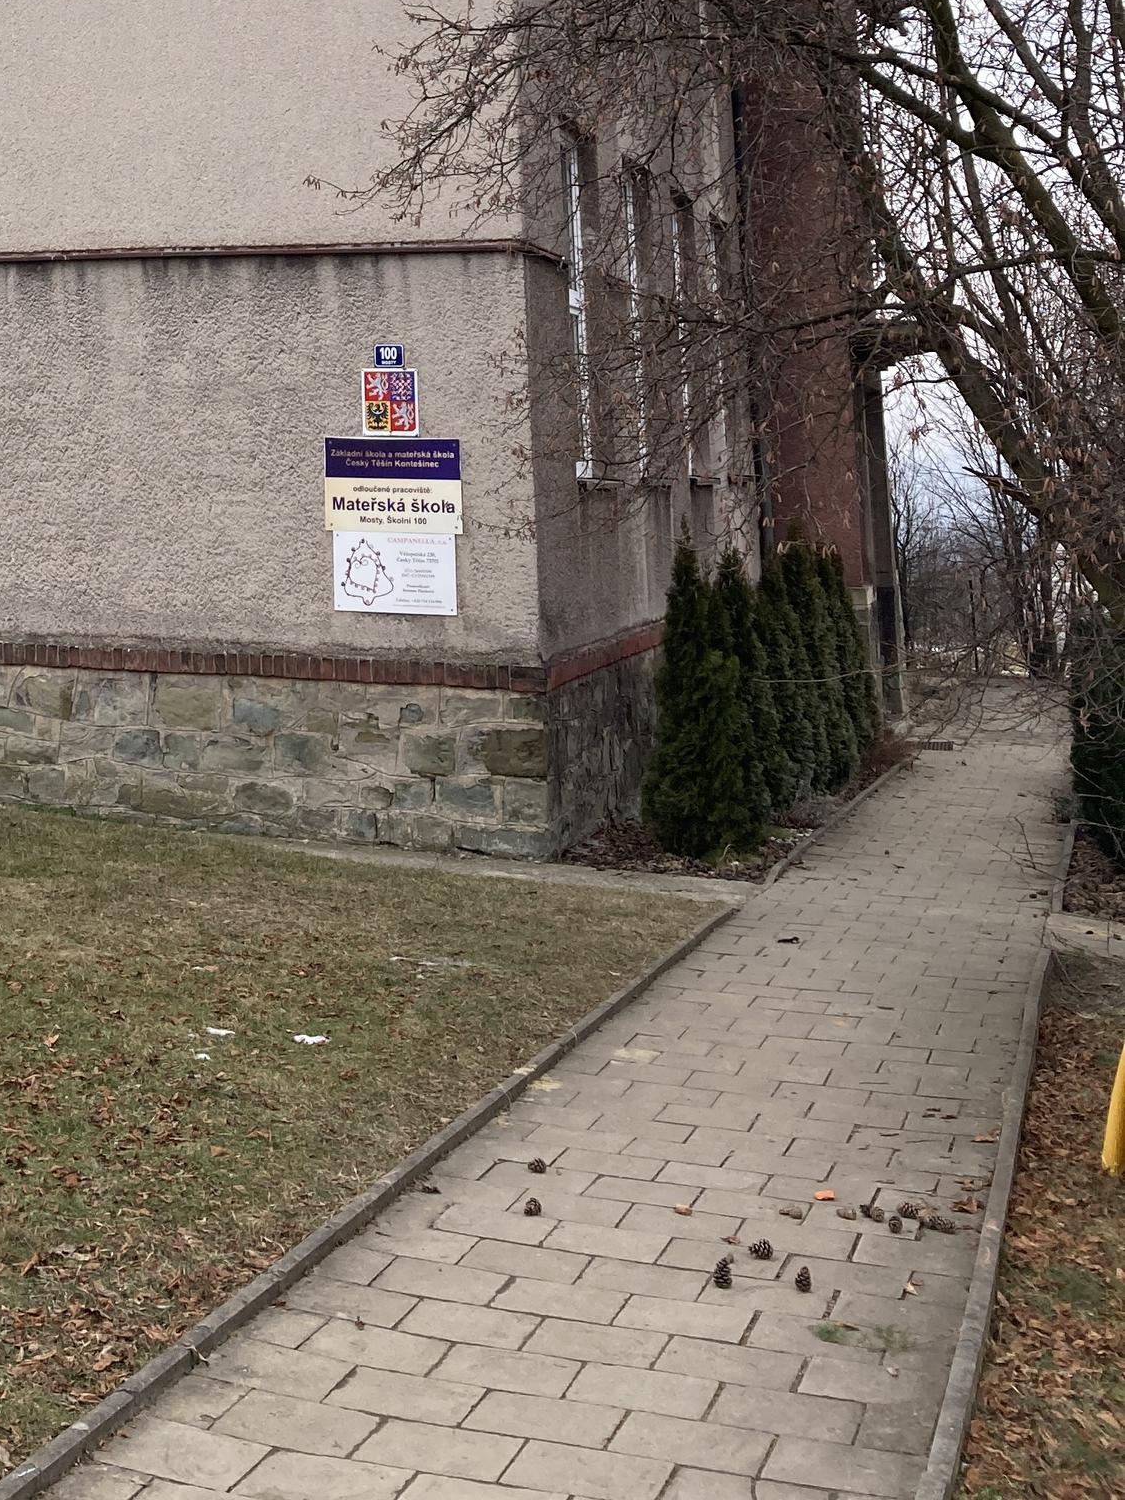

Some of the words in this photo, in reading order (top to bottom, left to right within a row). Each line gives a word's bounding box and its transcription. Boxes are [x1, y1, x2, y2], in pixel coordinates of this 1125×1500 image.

[380, 347, 397, 360] 100
[433, 450, 455, 459] škola
[345, 458, 369, 468] Český
[353, 485, 390, 493] odloučené
[332, 496, 405, 512] Mateřská
[411, 498, 455, 513] škola
[414, 517, 427, 525] 100
